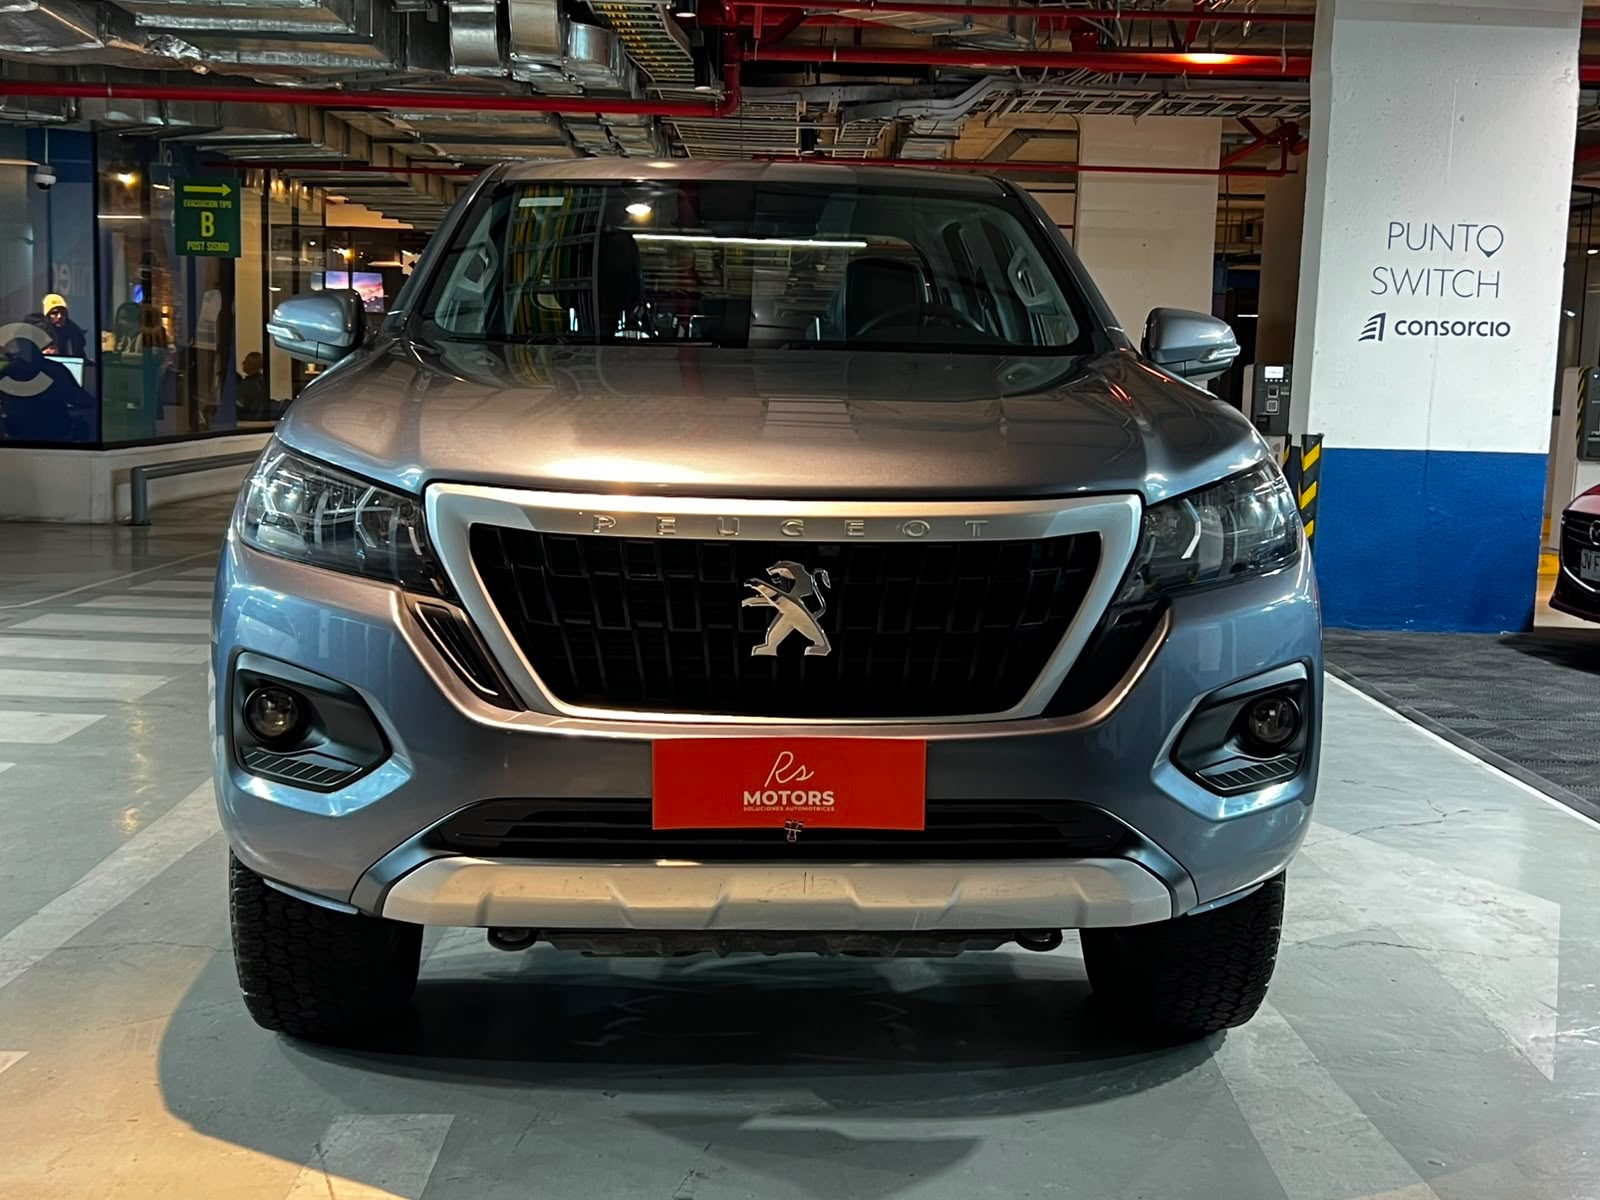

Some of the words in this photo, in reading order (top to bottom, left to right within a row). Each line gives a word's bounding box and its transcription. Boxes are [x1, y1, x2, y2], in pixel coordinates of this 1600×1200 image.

[201, 211, 215, 237] B
[187, 241, 205, 251] POST
[1388, 221, 1504, 258] PUNTO
[1370, 266, 1500, 299] SWITCH
[1394, 319, 1511, 337] consorcio
[592, 513, 989, 538] PEUGEOT
[764, 751, 815, 788] Rs
[743, 790, 835, 806] MOTORS
